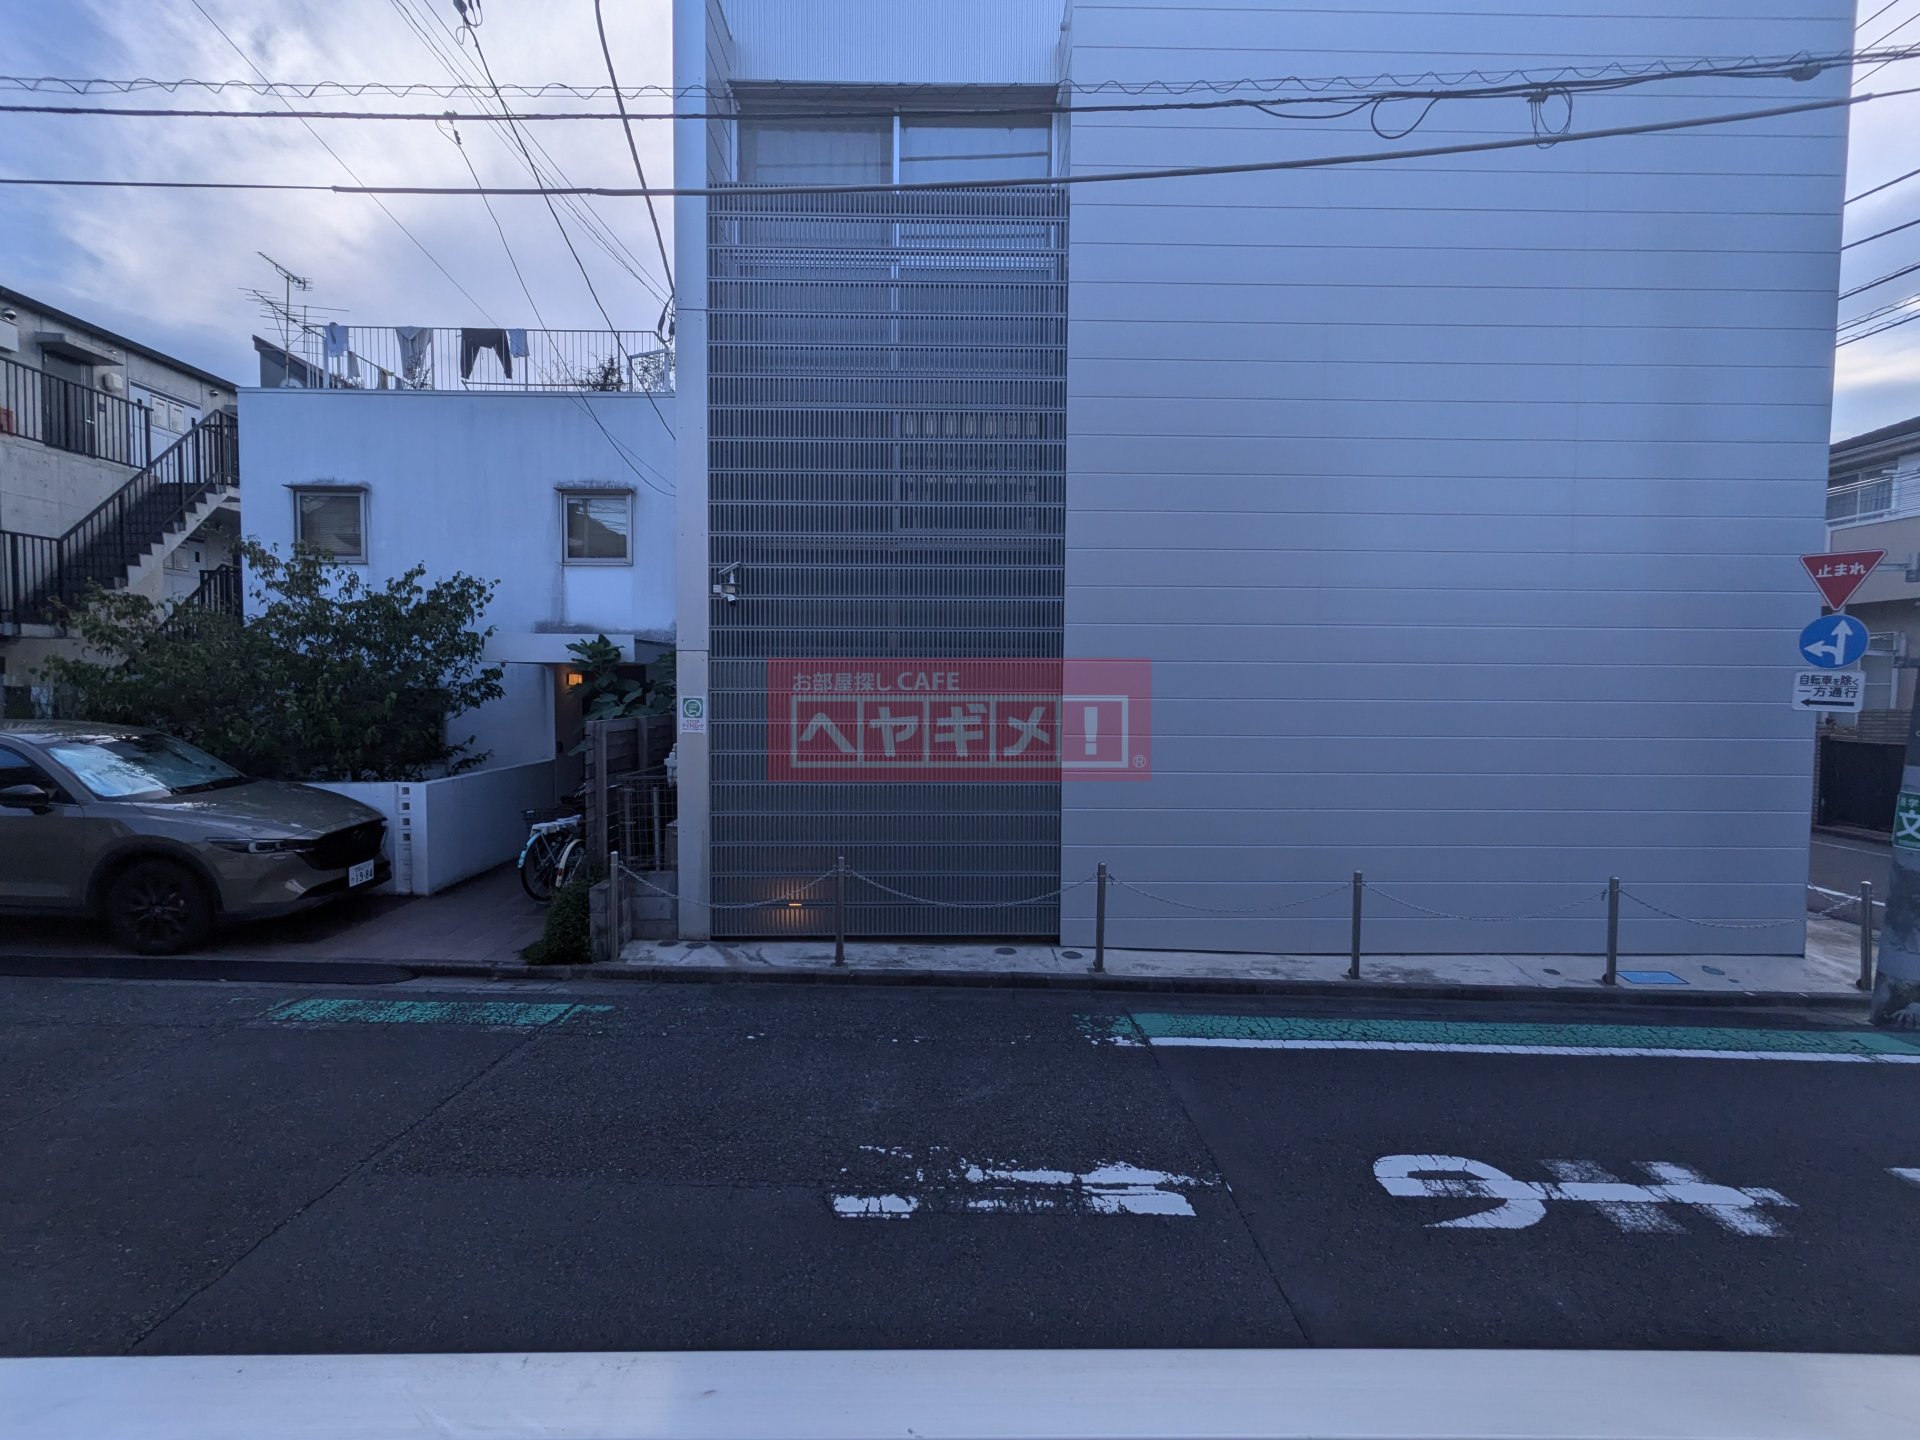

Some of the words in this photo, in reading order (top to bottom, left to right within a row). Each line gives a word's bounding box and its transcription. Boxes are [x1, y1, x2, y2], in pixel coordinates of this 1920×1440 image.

[1815, 562, 1867, 578] 止まれ
[1799, 674, 1859, 686] 自転車を除く
[1797, 687, 1859, 699] 一方通行
